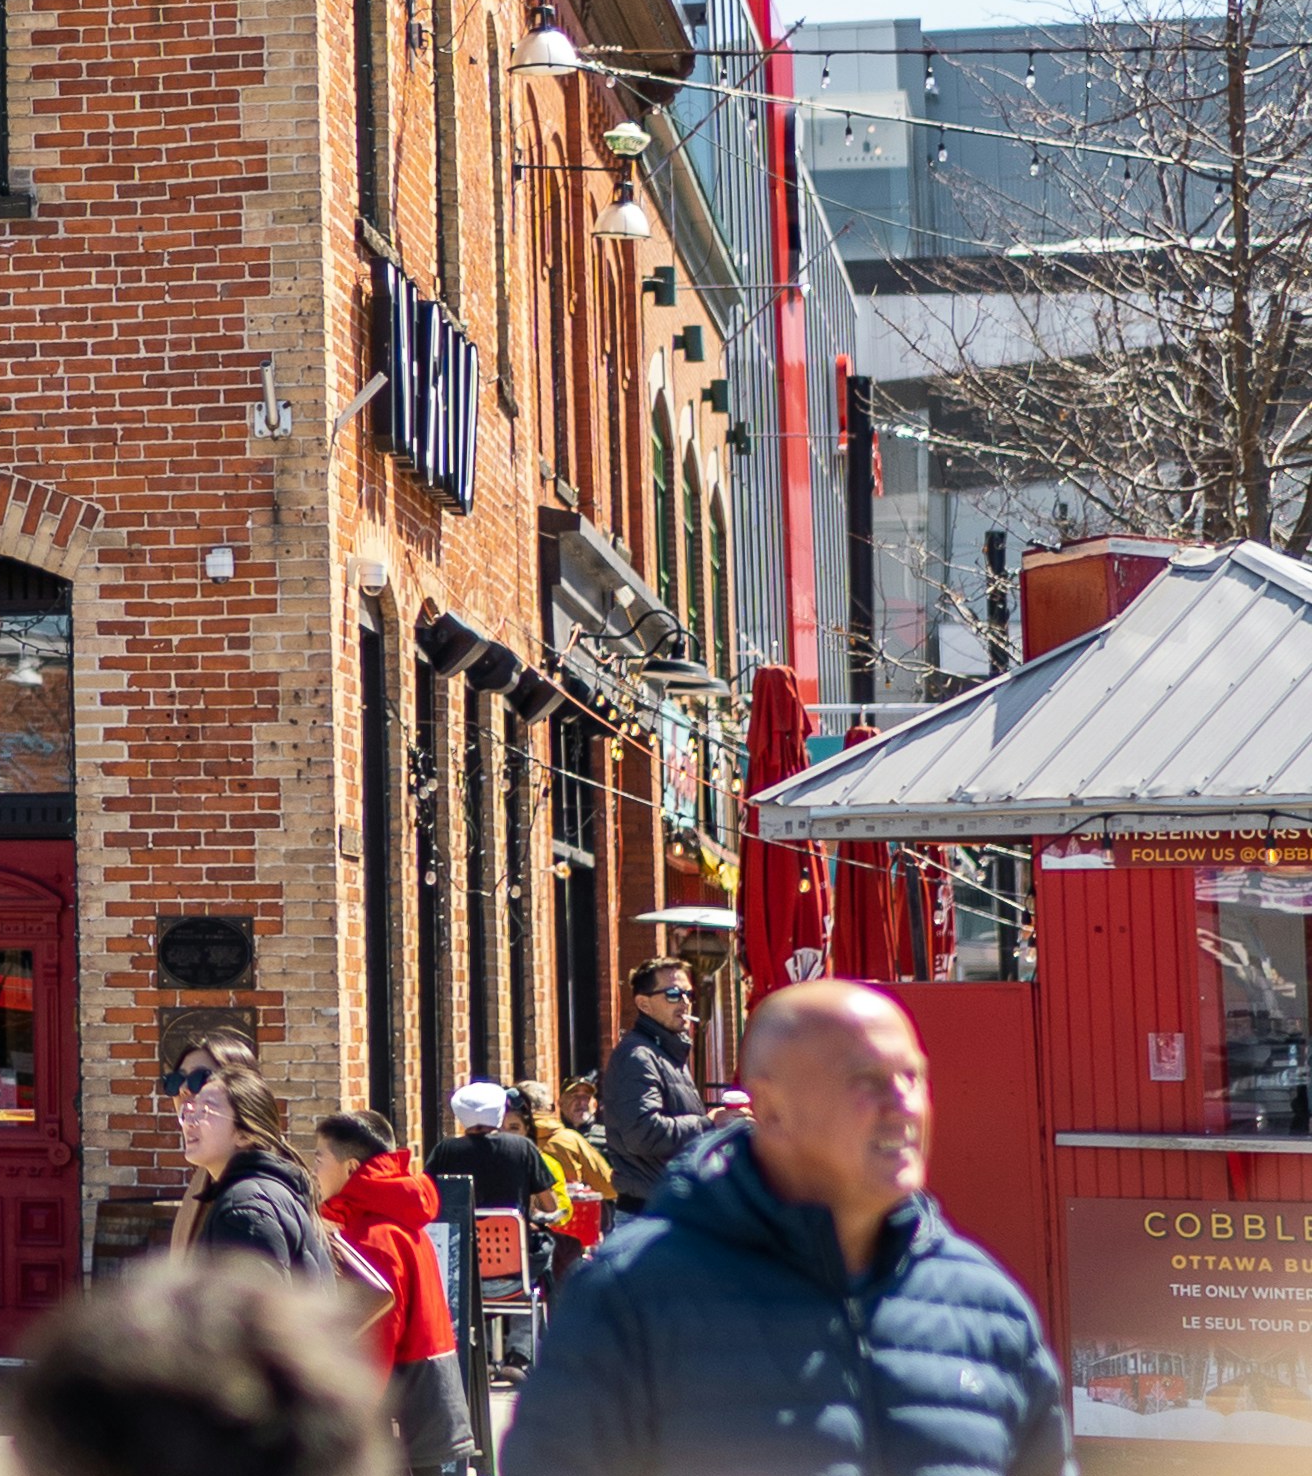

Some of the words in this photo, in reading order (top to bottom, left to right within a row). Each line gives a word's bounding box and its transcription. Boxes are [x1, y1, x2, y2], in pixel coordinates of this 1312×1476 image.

[1131, 848, 1206, 862] FOLLOW
[1212, 848, 1235, 861] US
[1171, 1255, 1273, 1272] OTTAWA
[1170, 1284, 1201, 1297] THE
[1206, 1285, 1248, 1299] ONLY
[1183, 1316, 1201, 1329] LE
[1205, 1317, 1245, 1331] SEUL
[1249, 1318, 1294, 1332] TOUR
